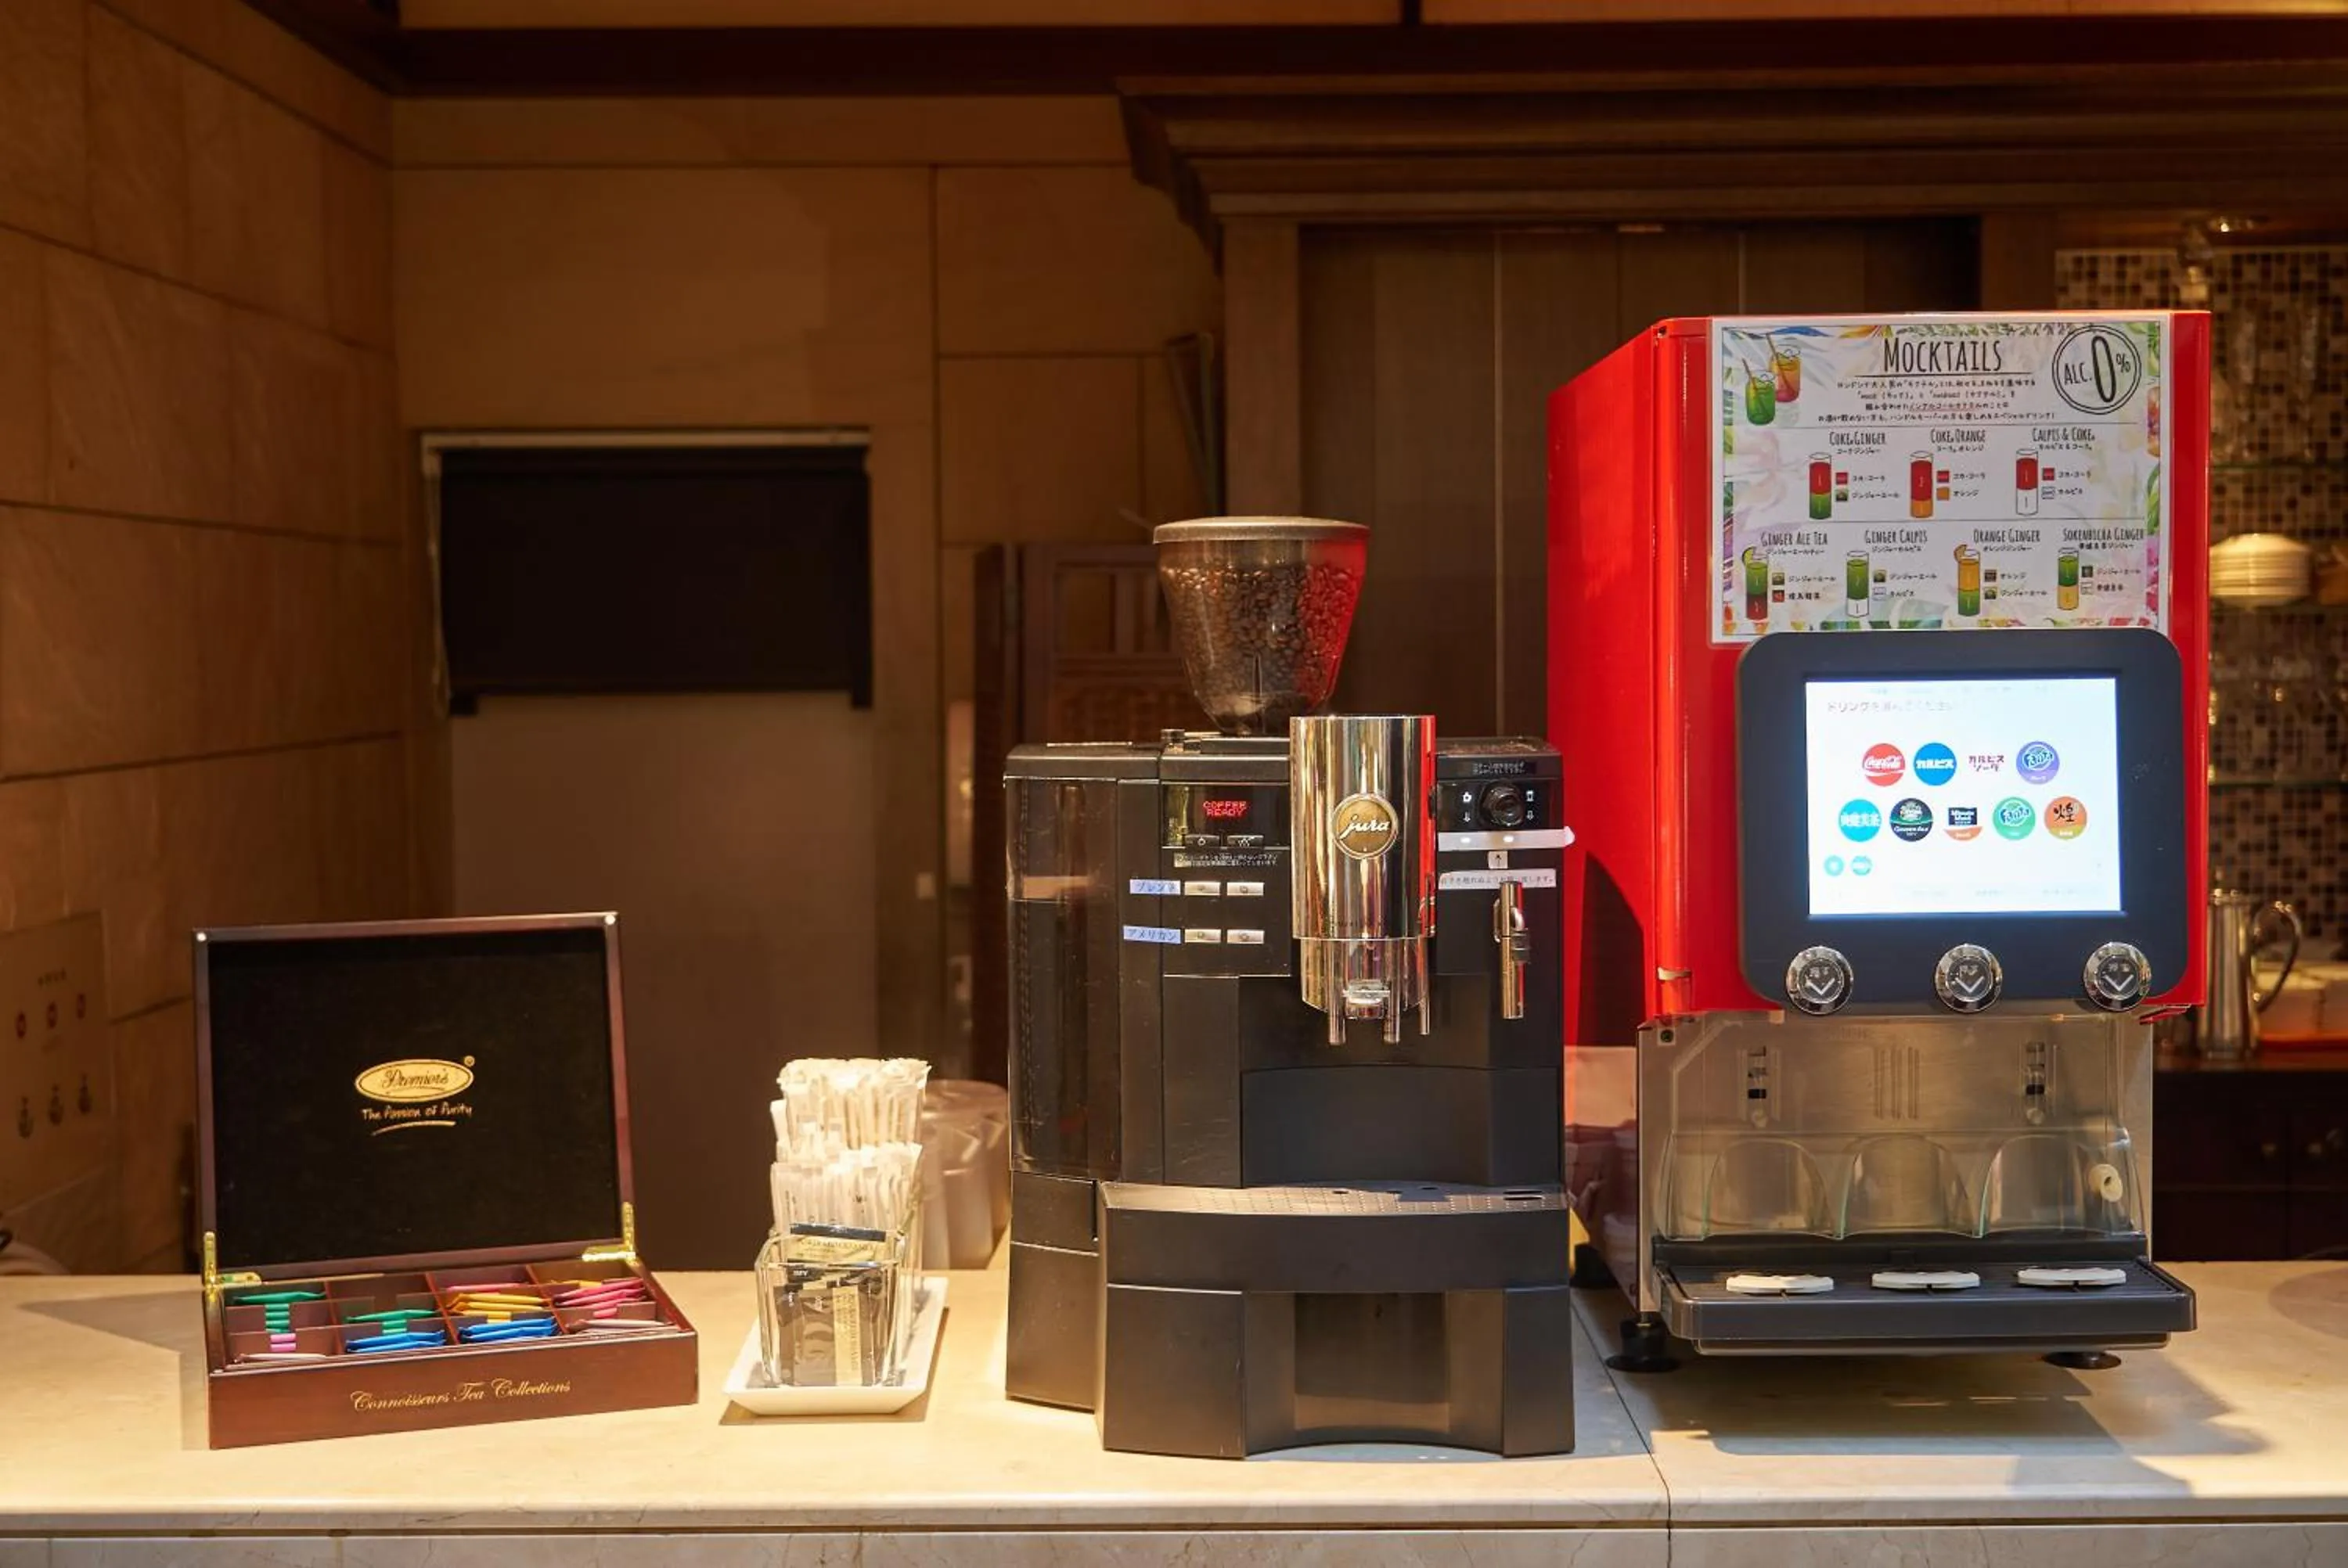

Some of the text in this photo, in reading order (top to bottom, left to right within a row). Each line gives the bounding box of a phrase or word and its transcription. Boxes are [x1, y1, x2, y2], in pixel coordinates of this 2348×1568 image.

[1884, 337, 2002, 373] MOCKTAILS
[2064, 362, 2092, 386] ALC.
[1761, 532, 1793, 547] GINGER
[1813, 531, 1828, 545] TEA
[1865, 530, 1896, 544] GINGER
[1973, 528, 2040, 543] ORANGE GINGER
[1203, 800, 1248, 809] COFFEE
[1206, 808, 1244, 817] READY
[1339, 814, 1390, 840] jura
[1128, 928, 1178, 941] アメリカン
[362, 1108, 381, 1120] The
[425, 1104, 438, 1117] of
[350, 1377, 571, 1412] Connoisseurs Tea Collections
